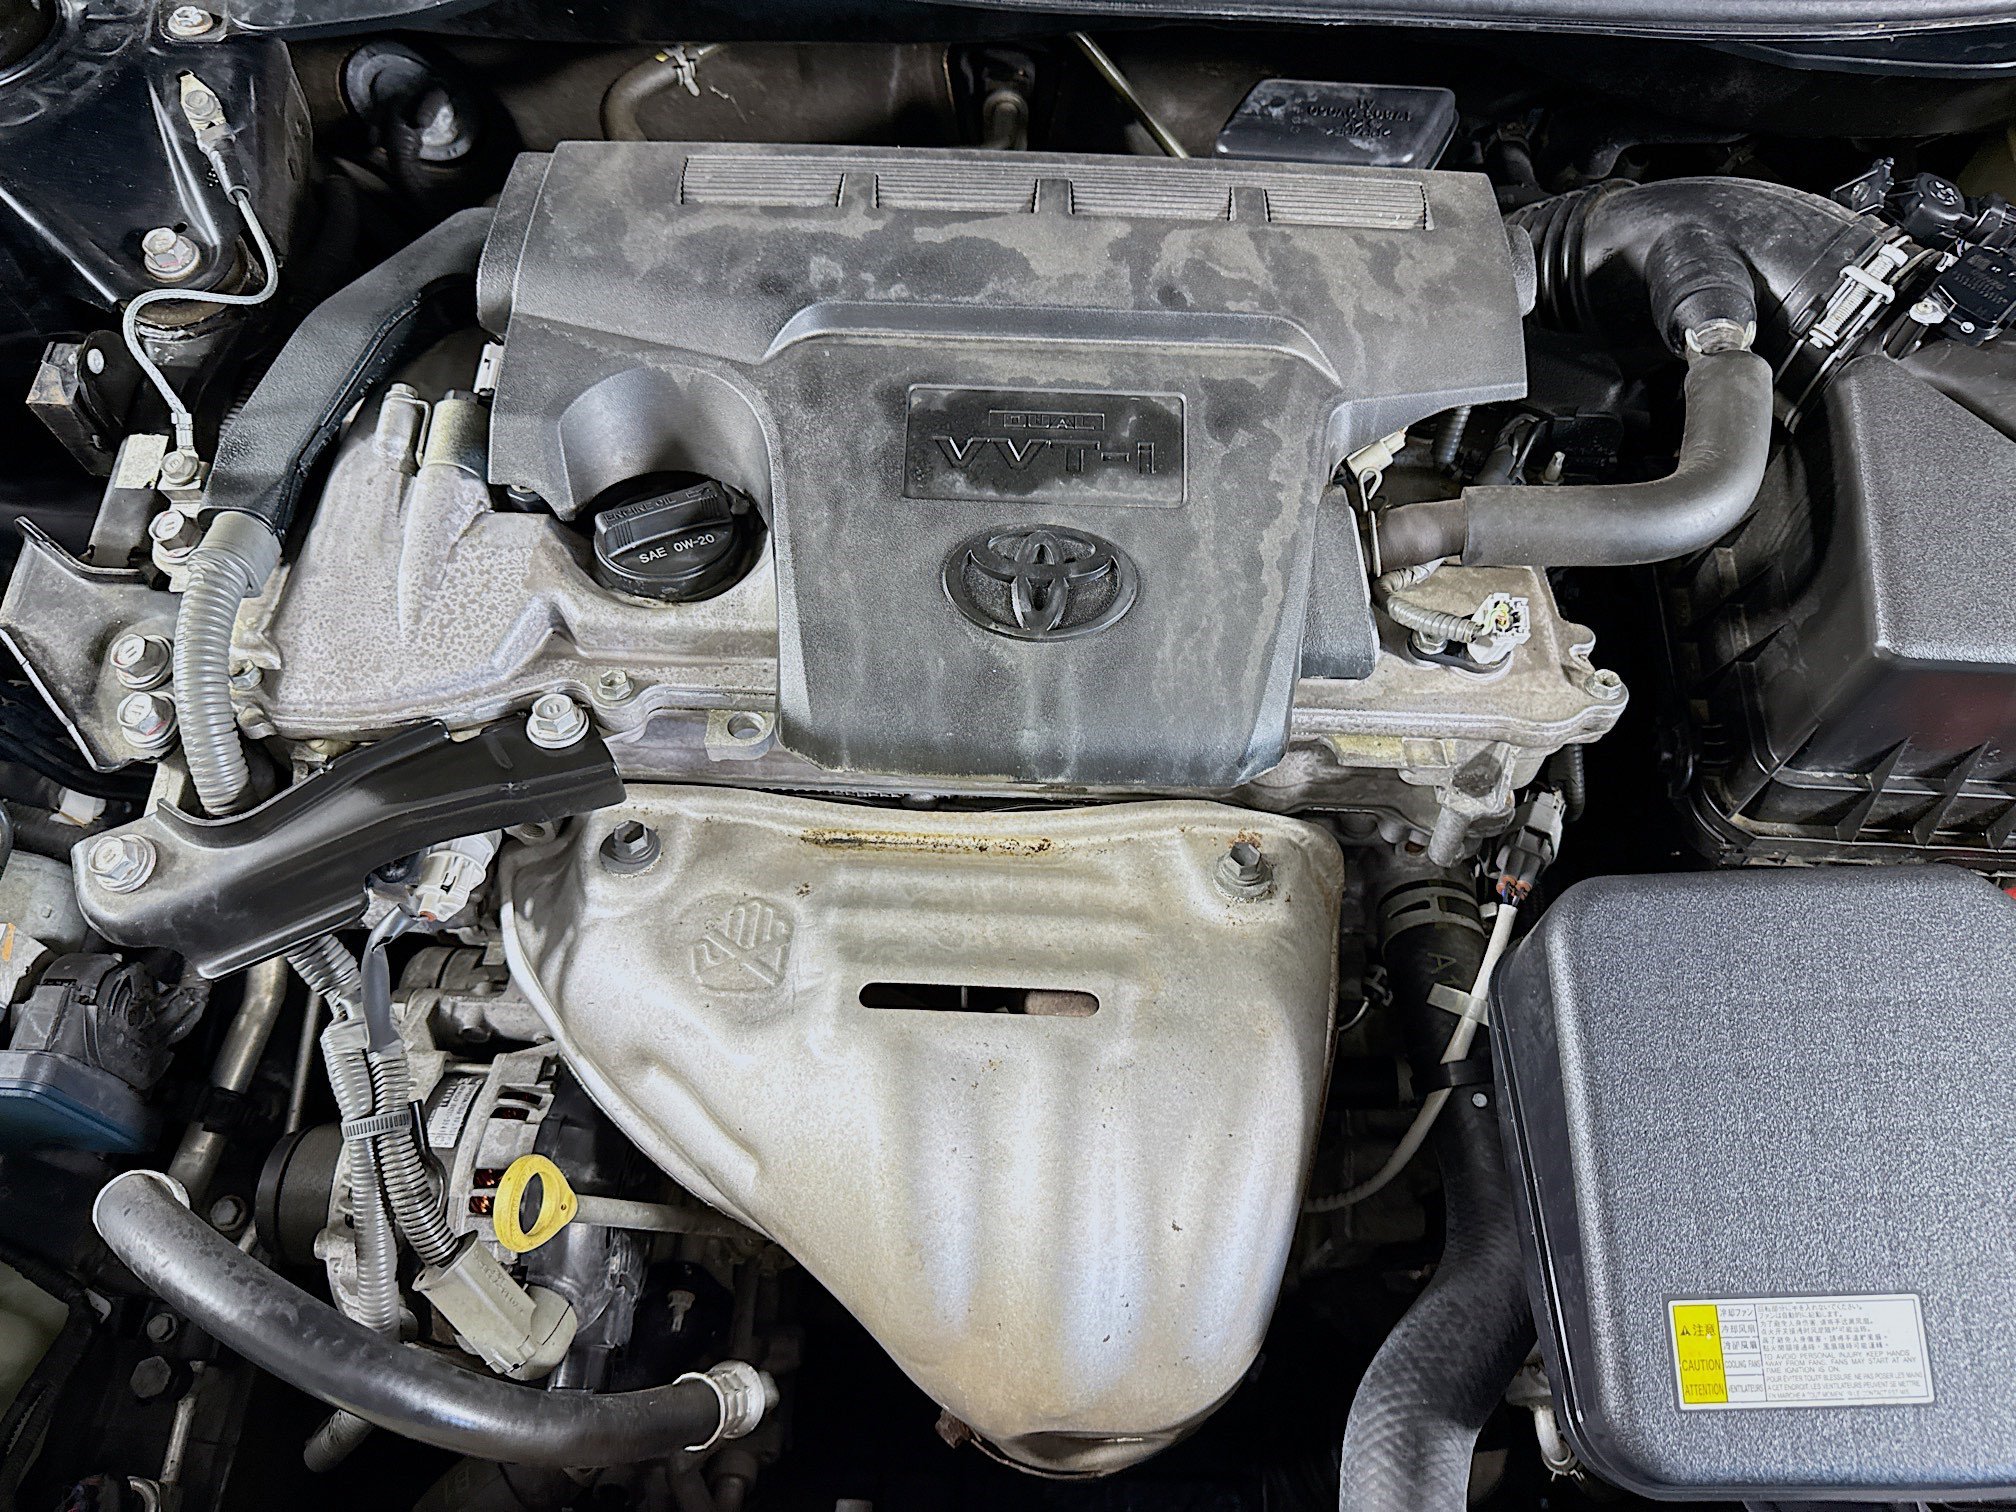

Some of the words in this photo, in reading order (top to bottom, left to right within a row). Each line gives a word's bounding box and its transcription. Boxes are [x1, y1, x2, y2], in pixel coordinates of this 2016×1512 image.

[1003, 413, 1096, 431] DUAL
[604, 502, 654, 524] ENGINE
[655, 496, 677, 508] OIL
[638, 546, 668, 564] SAE
[673, 533, 716, 553] 0W-20
[1719, 1308, 1753, 1317] 冷却ファン
[1692, 1323, 1715, 1336] 注意
[1680, 1358, 1721, 1371] CAUTION
[1724, 1359, 1746, 1369] COOLING
[1747, 1359, 1760, 1368] FANS
[1766, 1374, 1782, 1382] POUR
[1874, 1371, 1893, 1379] POSER
[1905, 1370, 1922, 1378] MAINS
[1683, 1383, 1724, 1396] ATTENTION
[1727, 1383, 1763, 1393] VENTILATEURS
